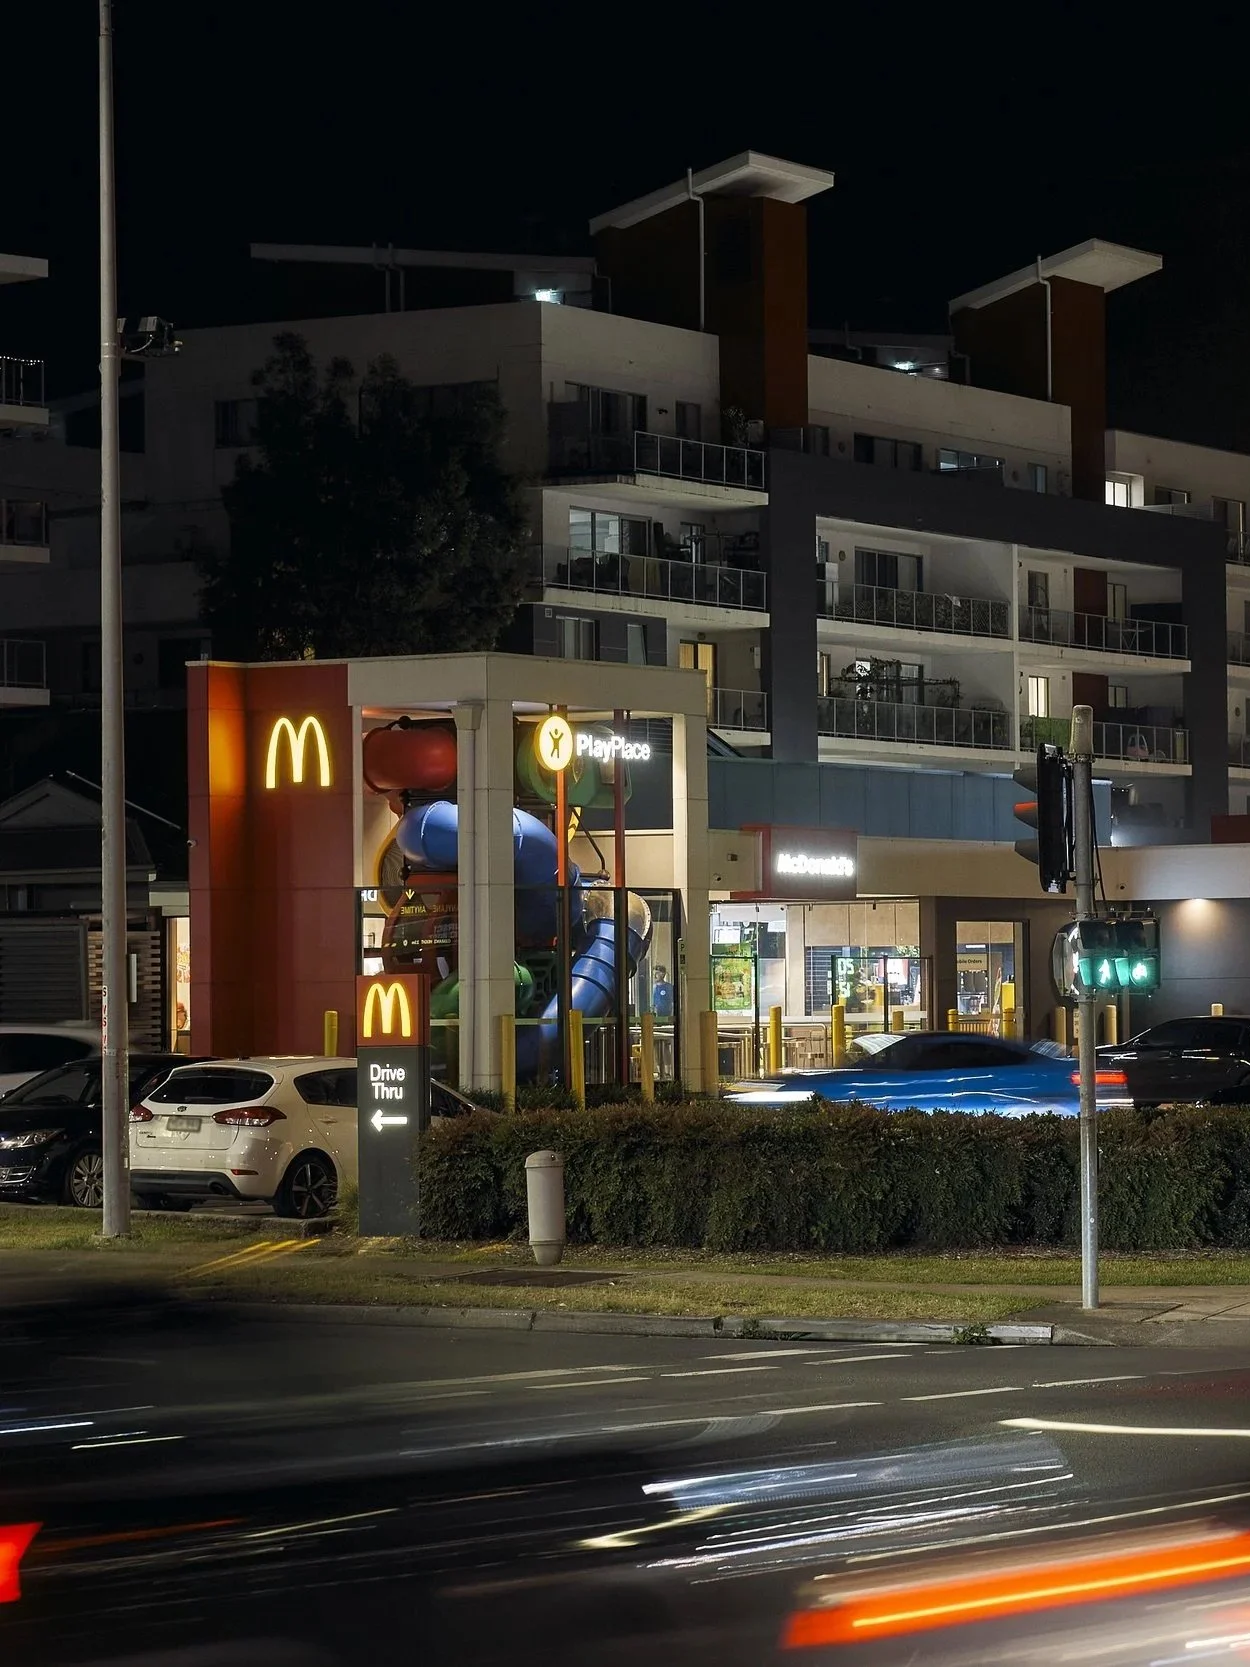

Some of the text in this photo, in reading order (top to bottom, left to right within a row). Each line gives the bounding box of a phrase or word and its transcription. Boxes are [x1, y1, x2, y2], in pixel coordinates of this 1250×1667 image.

[576, 733, 651, 763] PlayPlace
[777, 852, 855, 877] McDonald's
[369, 1063, 406, 1082] Drive
[371, 1082, 404, 1100] Thru
